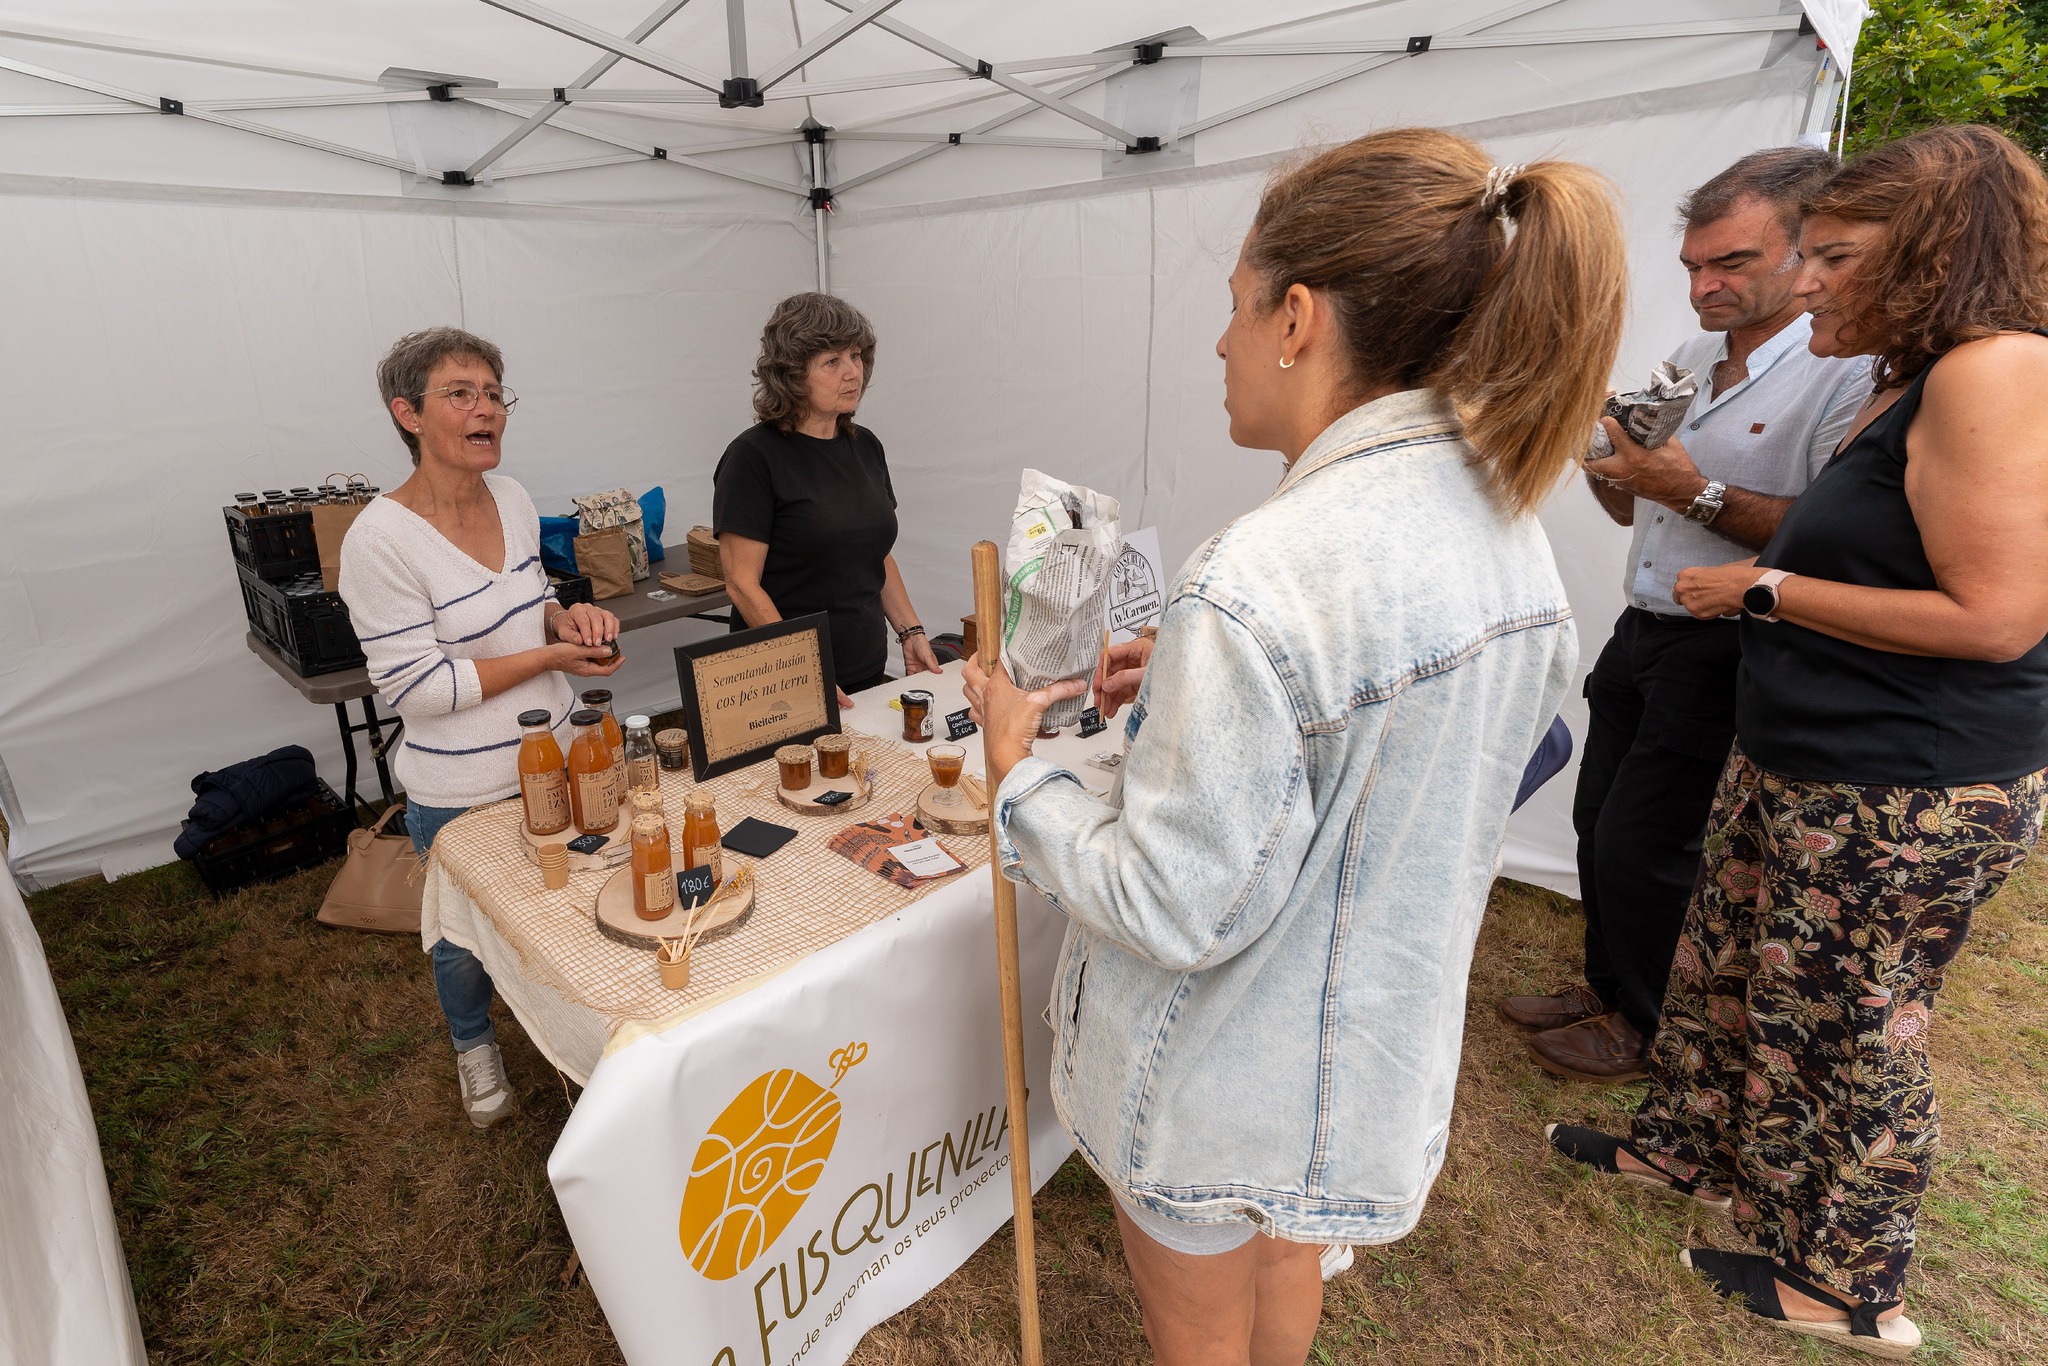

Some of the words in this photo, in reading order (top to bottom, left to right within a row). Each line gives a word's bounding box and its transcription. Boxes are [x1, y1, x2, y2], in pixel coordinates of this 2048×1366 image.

[713, 662, 773, 689] Sementando
[775, 652, 806, 671] ilusión
[716, 695, 736, 710] cos
[739, 686, 759, 707] pés
[762, 684, 777, 697] na
[780, 673, 808, 691] terra
[824, 1253, 891, 1328] agroman
[894, 1235, 912, 1256] os
[914, 1206, 947, 1238] teus
